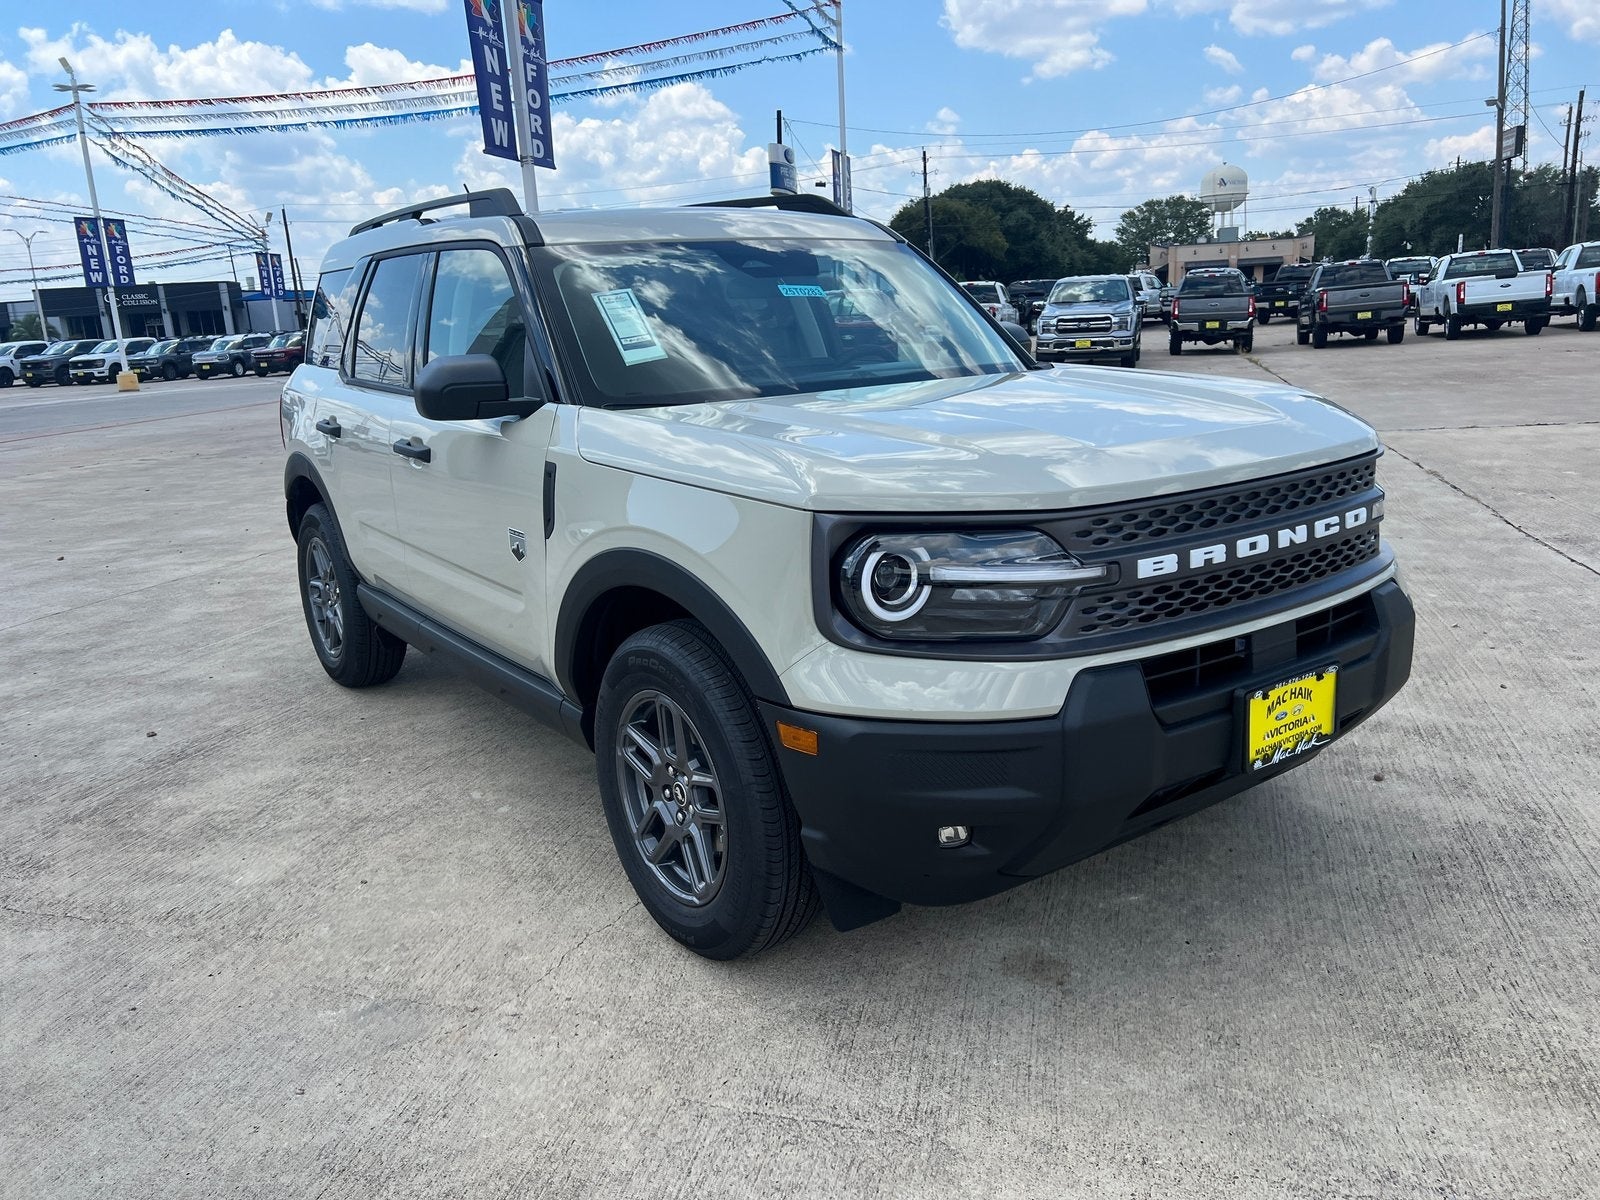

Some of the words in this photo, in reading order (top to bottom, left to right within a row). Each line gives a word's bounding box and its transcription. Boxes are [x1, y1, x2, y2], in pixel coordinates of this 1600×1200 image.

[483, 44, 508, 148] NEW
[526, 62, 545, 159] FORD
[86, 244, 103, 283] NEW
[115, 245, 129, 284] FORD
[261, 270, 271, 296] NEW
[275, 271, 284, 296] FORD
[782, 287, 823, 296] 25T0283
[1137, 507, 1368, 579] BRONCO
[1266, 690, 1288, 719] MAC
[1289, 686, 1313, 702] HAIK
[1269, 716, 1309, 739] VICTORIA
[1272, 747, 1294, 765] Mac
[1294, 733, 1331, 755] Haik
